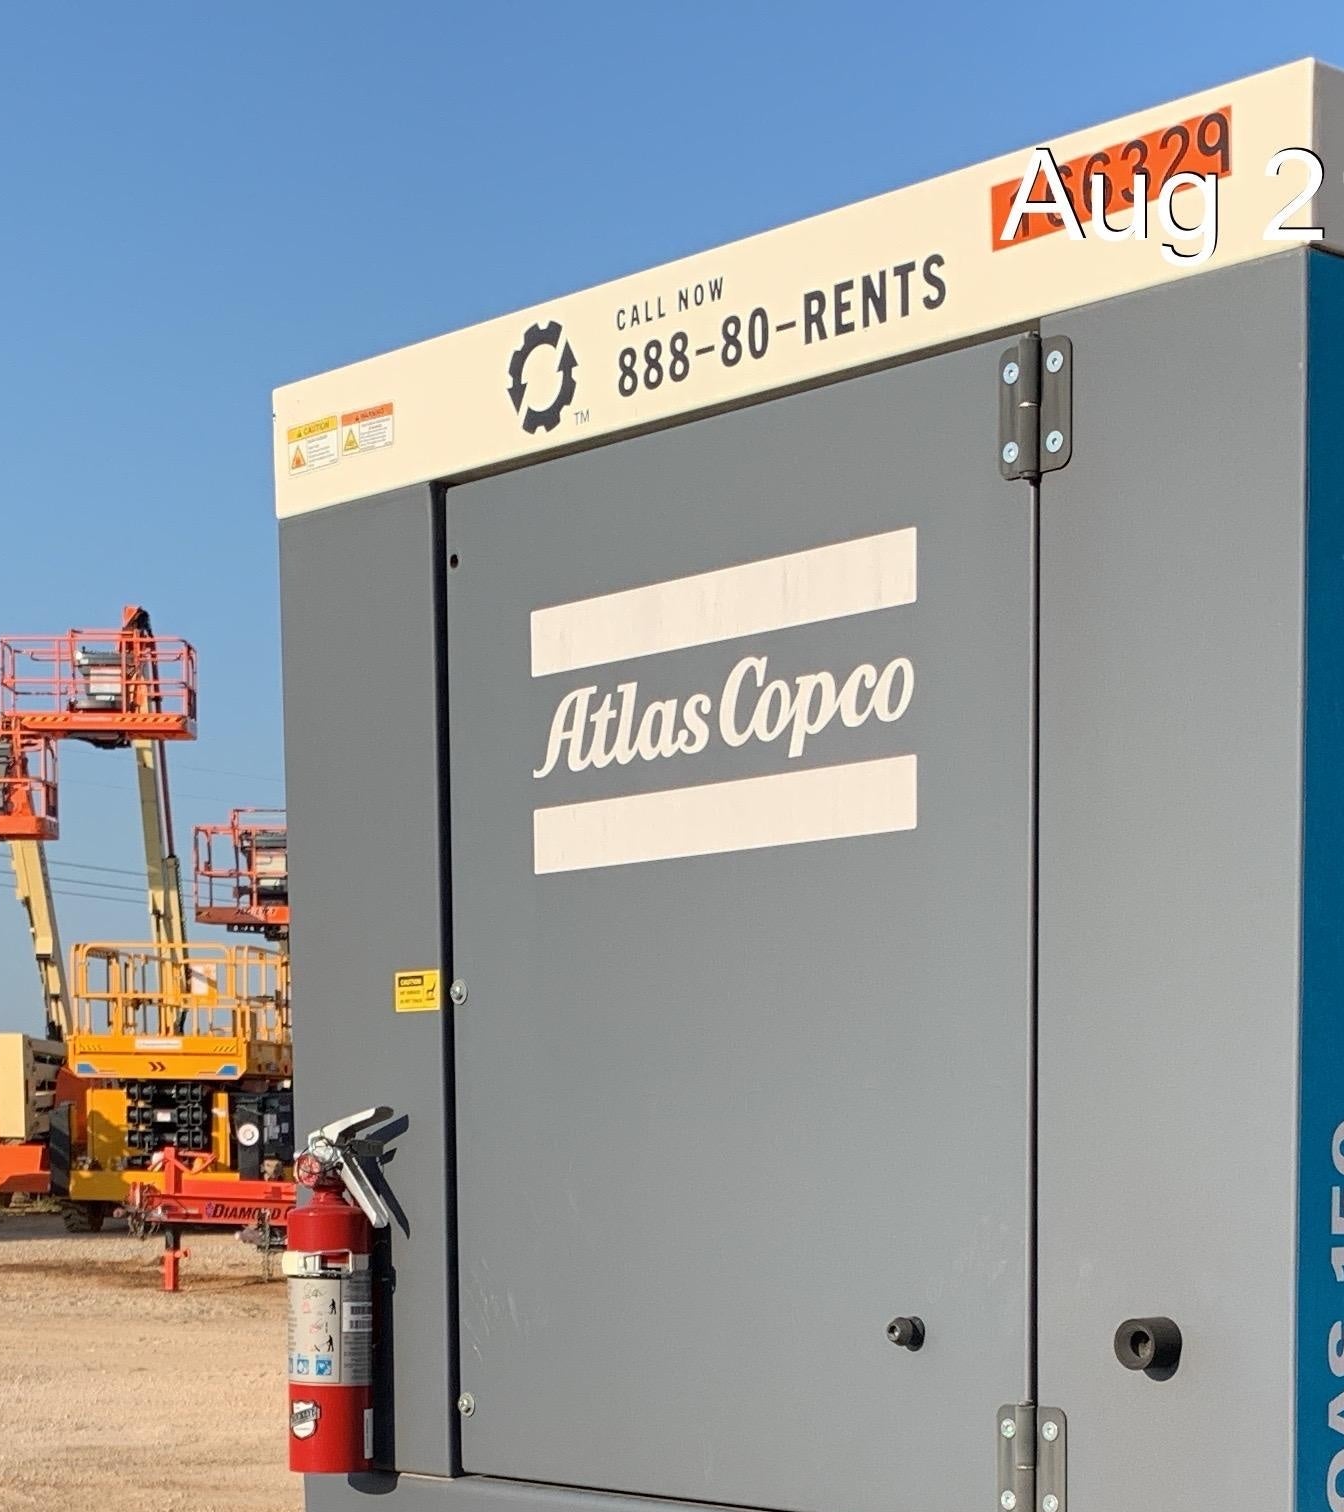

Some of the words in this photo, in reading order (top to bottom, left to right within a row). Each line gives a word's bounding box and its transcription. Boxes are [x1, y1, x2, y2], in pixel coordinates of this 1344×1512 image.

[617, 297, 667, 330] CALL
[678, 277, 726, 315] NOW
[618, 256, 947, 398] 888-80-RENTS
[304, 421, 329, 435] CAUTION
[533, 681, 709, 779] Atlas
[720, 656, 914, 758] Copco
